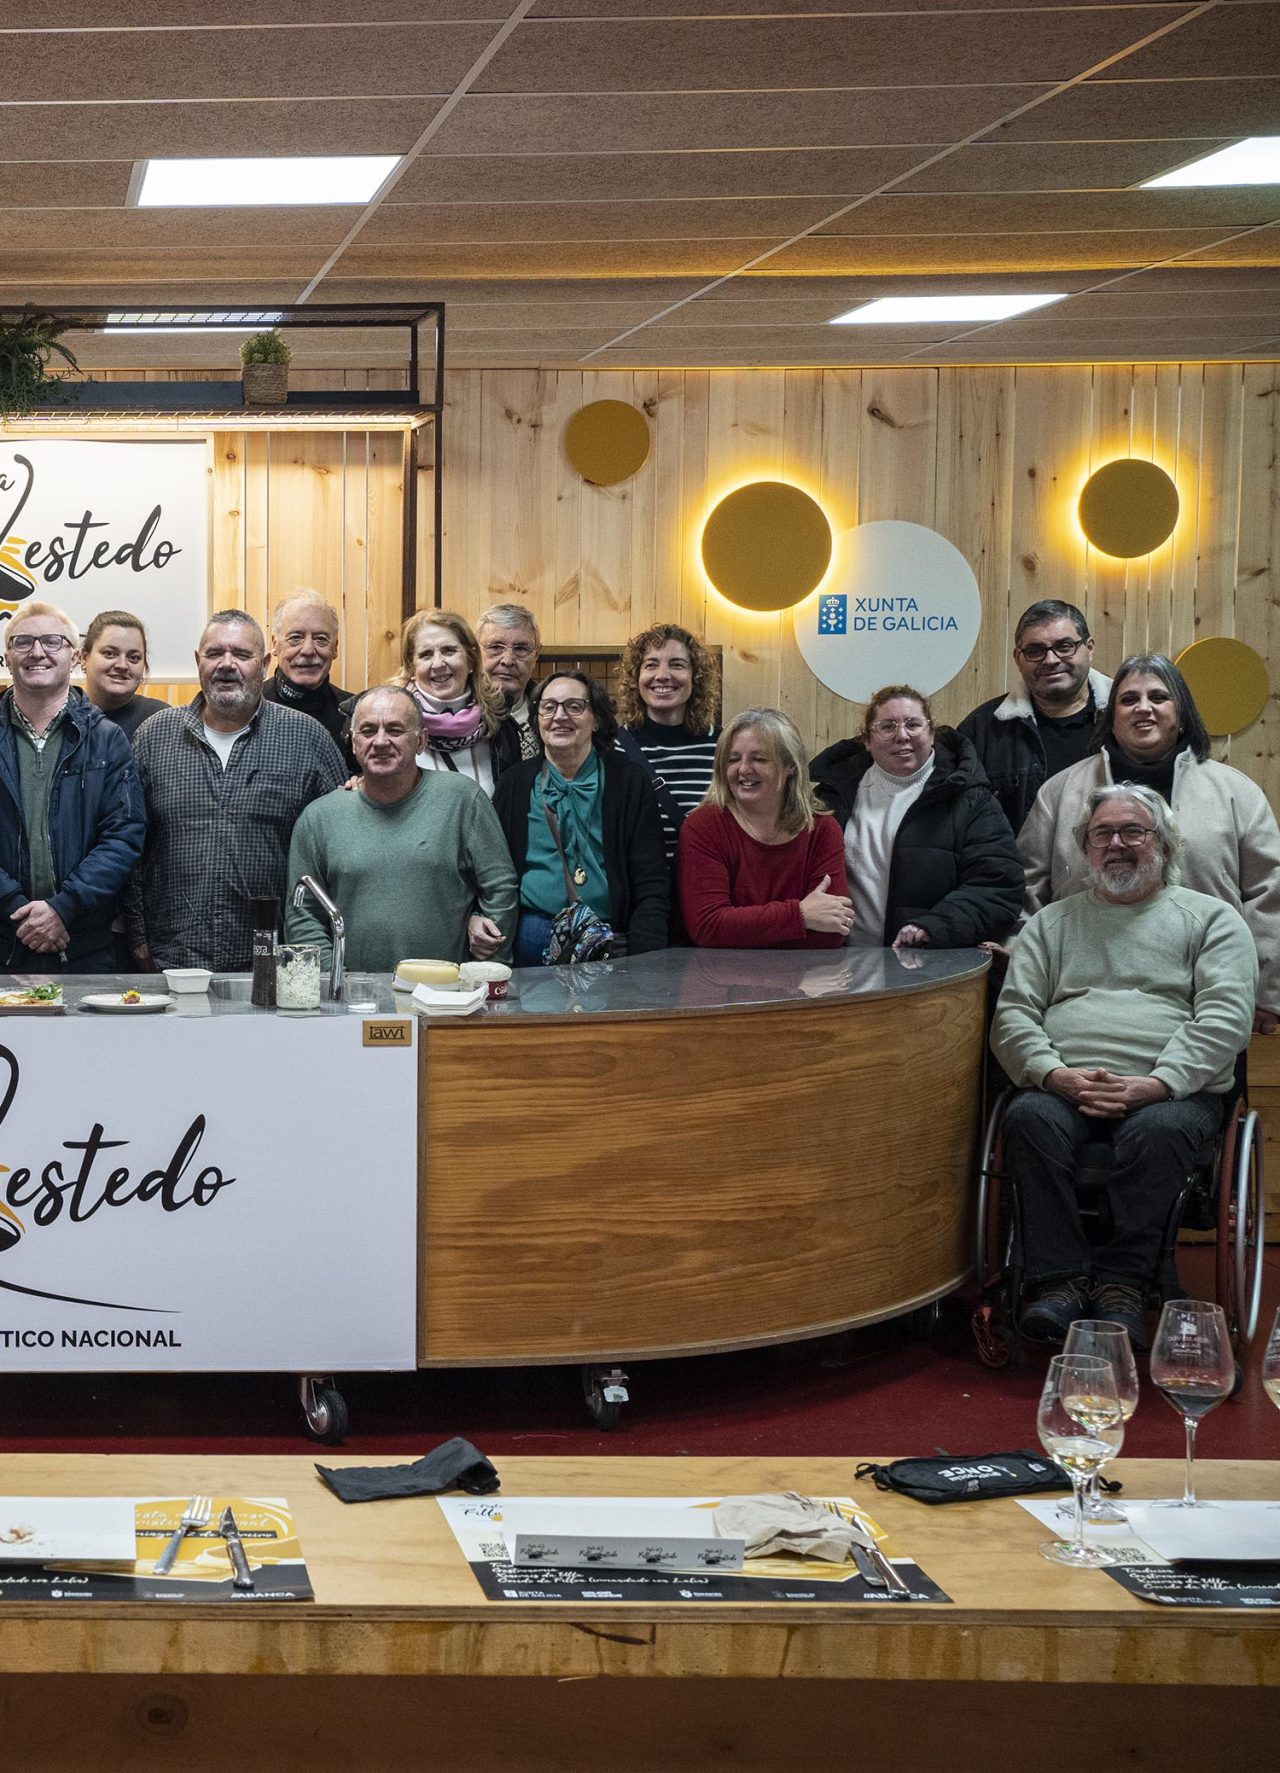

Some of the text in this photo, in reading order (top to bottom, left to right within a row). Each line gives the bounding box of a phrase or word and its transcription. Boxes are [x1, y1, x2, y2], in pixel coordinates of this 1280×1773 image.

[855, 597, 918, 612] XUNTA
[854, 616, 959, 631] DE GALICIA
[61, 1330, 182, 1348] NACIONAL
